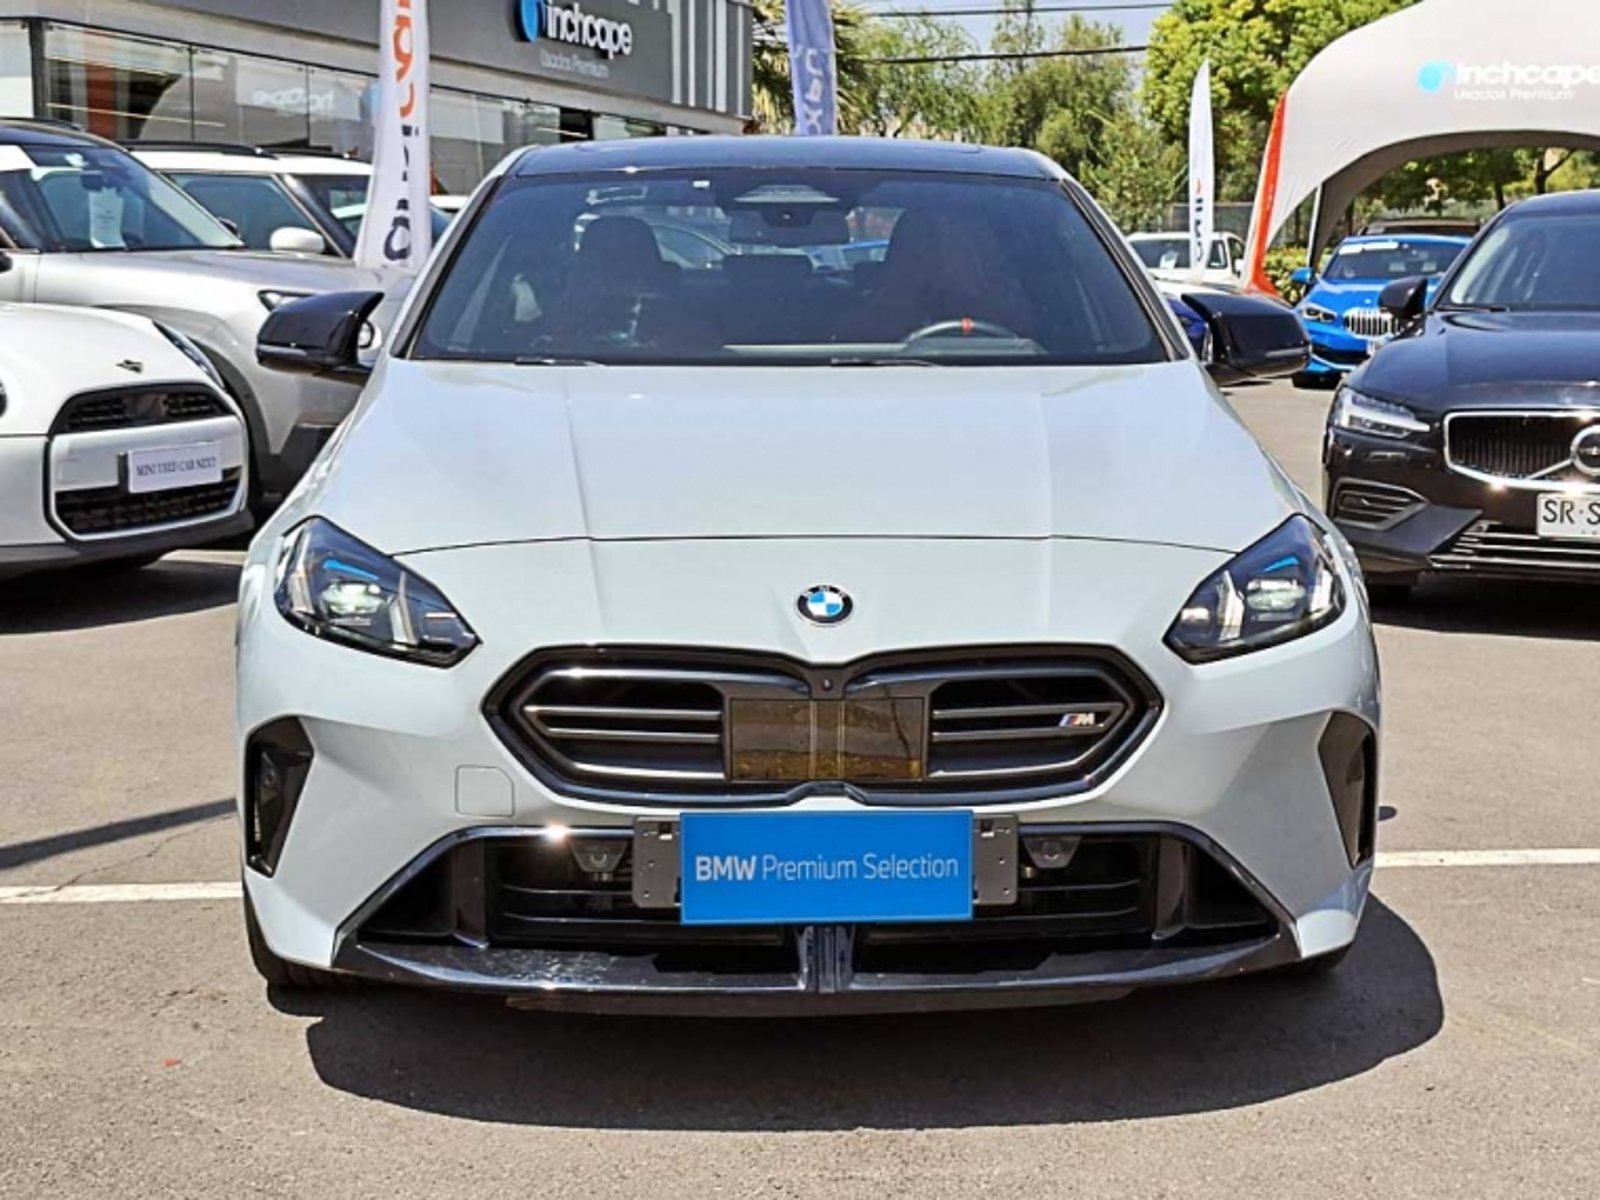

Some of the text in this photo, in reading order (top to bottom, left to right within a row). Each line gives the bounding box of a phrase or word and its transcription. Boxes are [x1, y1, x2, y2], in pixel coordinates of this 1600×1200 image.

[547, 0, 633, 60] inchcape
[1510, 87, 1575, 101] Premium
[695, 853, 960, 881] BMW Premium Selection
